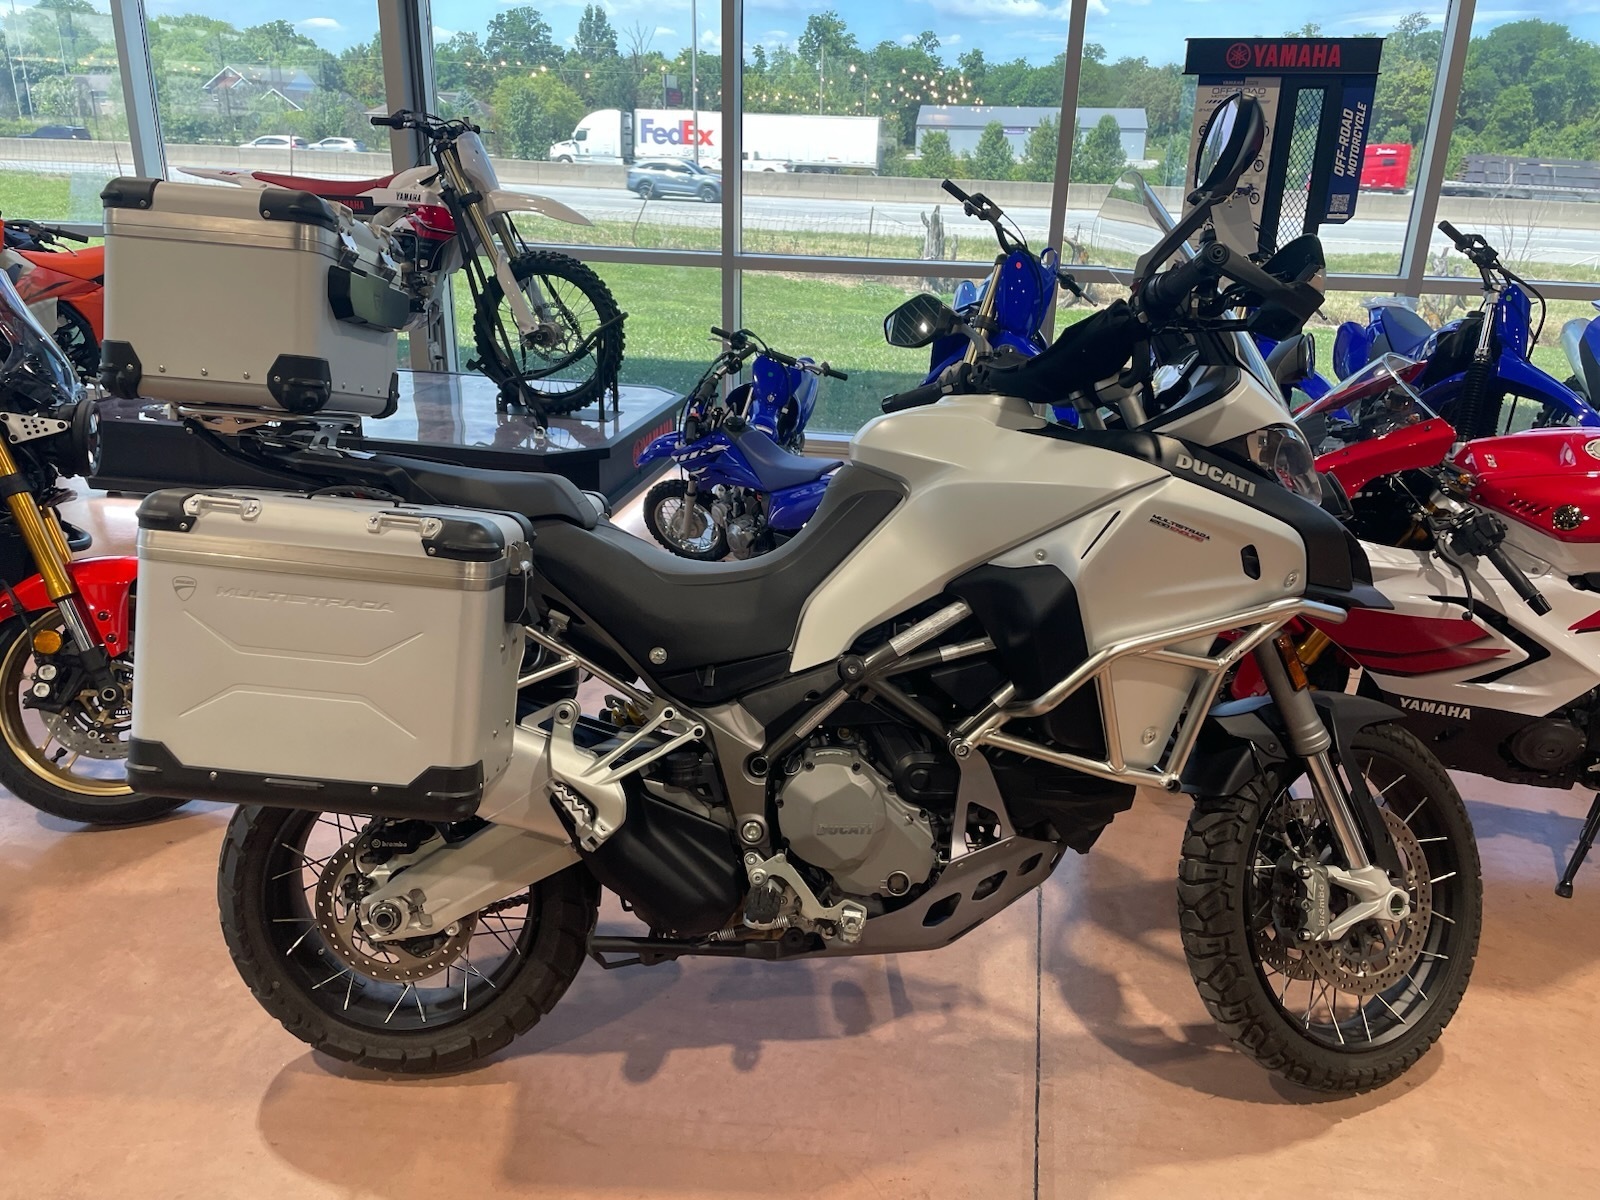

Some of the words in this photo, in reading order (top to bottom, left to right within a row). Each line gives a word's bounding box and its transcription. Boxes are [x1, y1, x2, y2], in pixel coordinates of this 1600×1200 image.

[1253, 44, 1341, 68] YAMAHA
[640, 118, 714, 146] FedEx
[1334, 108, 1354, 177] OFF-ROAD
[1346, 102, 1367, 177] MOTORCYCLE
[395, 191, 422, 202] YAMAHA
[1175, 453, 1256, 498] DUCATI
[215, 586, 394, 613] MULTISTRADA
[1400, 697, 1471, 721] YAMAHA
[816, 823, 873, 836] DUCATI
